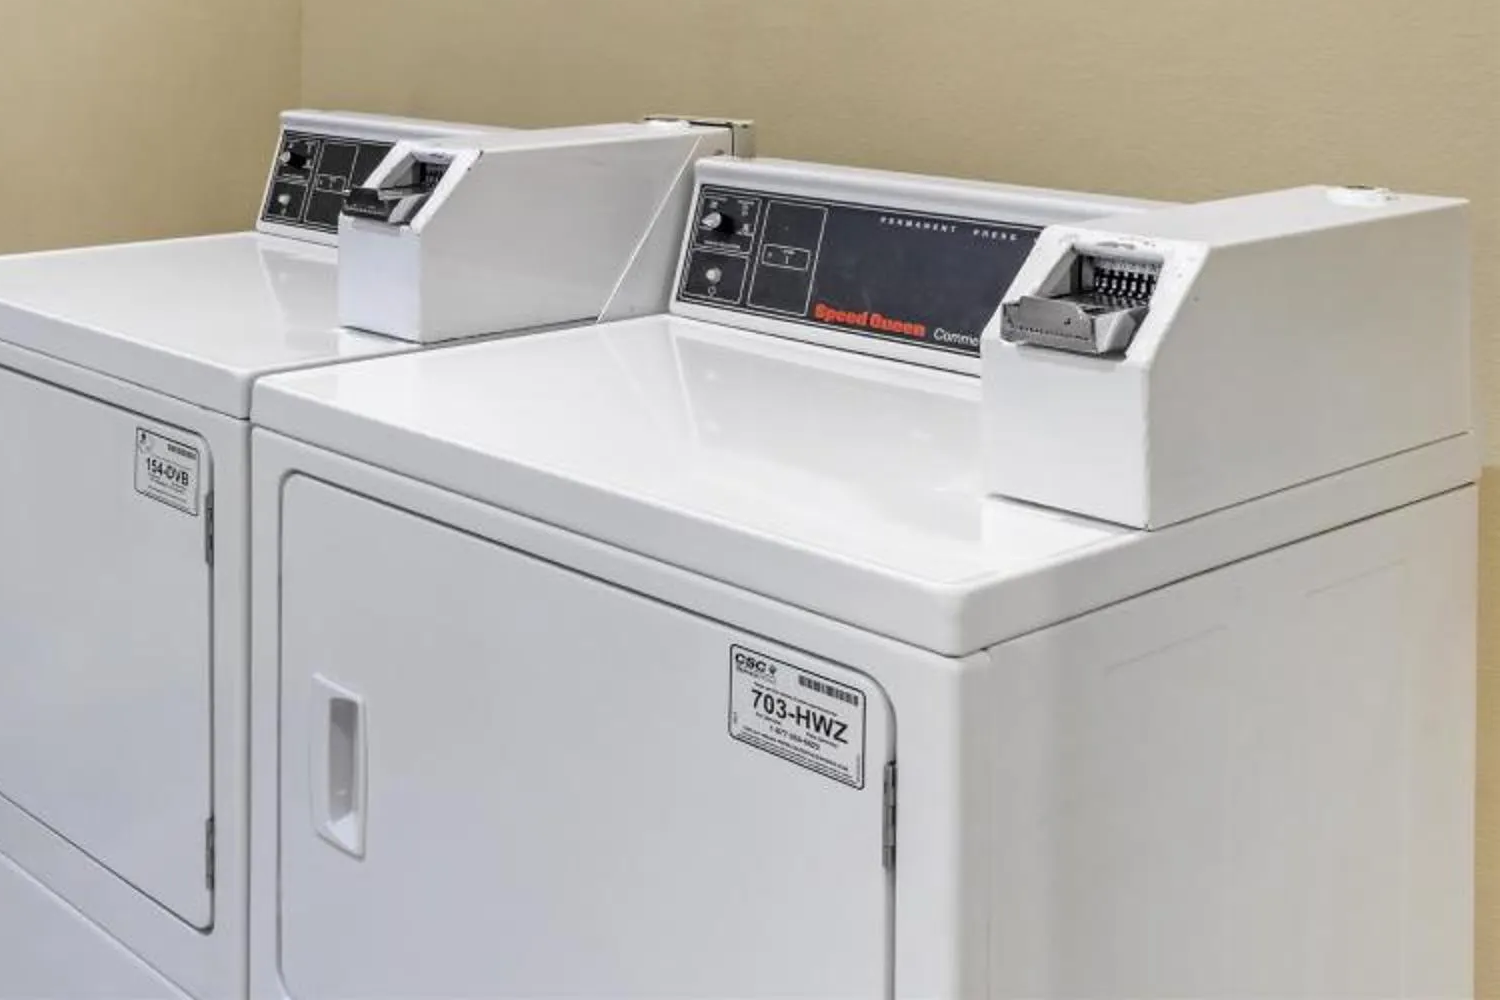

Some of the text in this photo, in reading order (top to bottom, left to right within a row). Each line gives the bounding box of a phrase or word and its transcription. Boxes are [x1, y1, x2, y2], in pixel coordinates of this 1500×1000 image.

[880, 216, 956, 233] PERMANENT
[815, 303, 868, 327] Speed
[869, 312, 927, 337] Queen
[735, 653, 766, 673] CSC
[751, 688, 848, 745] 703-HWZ
